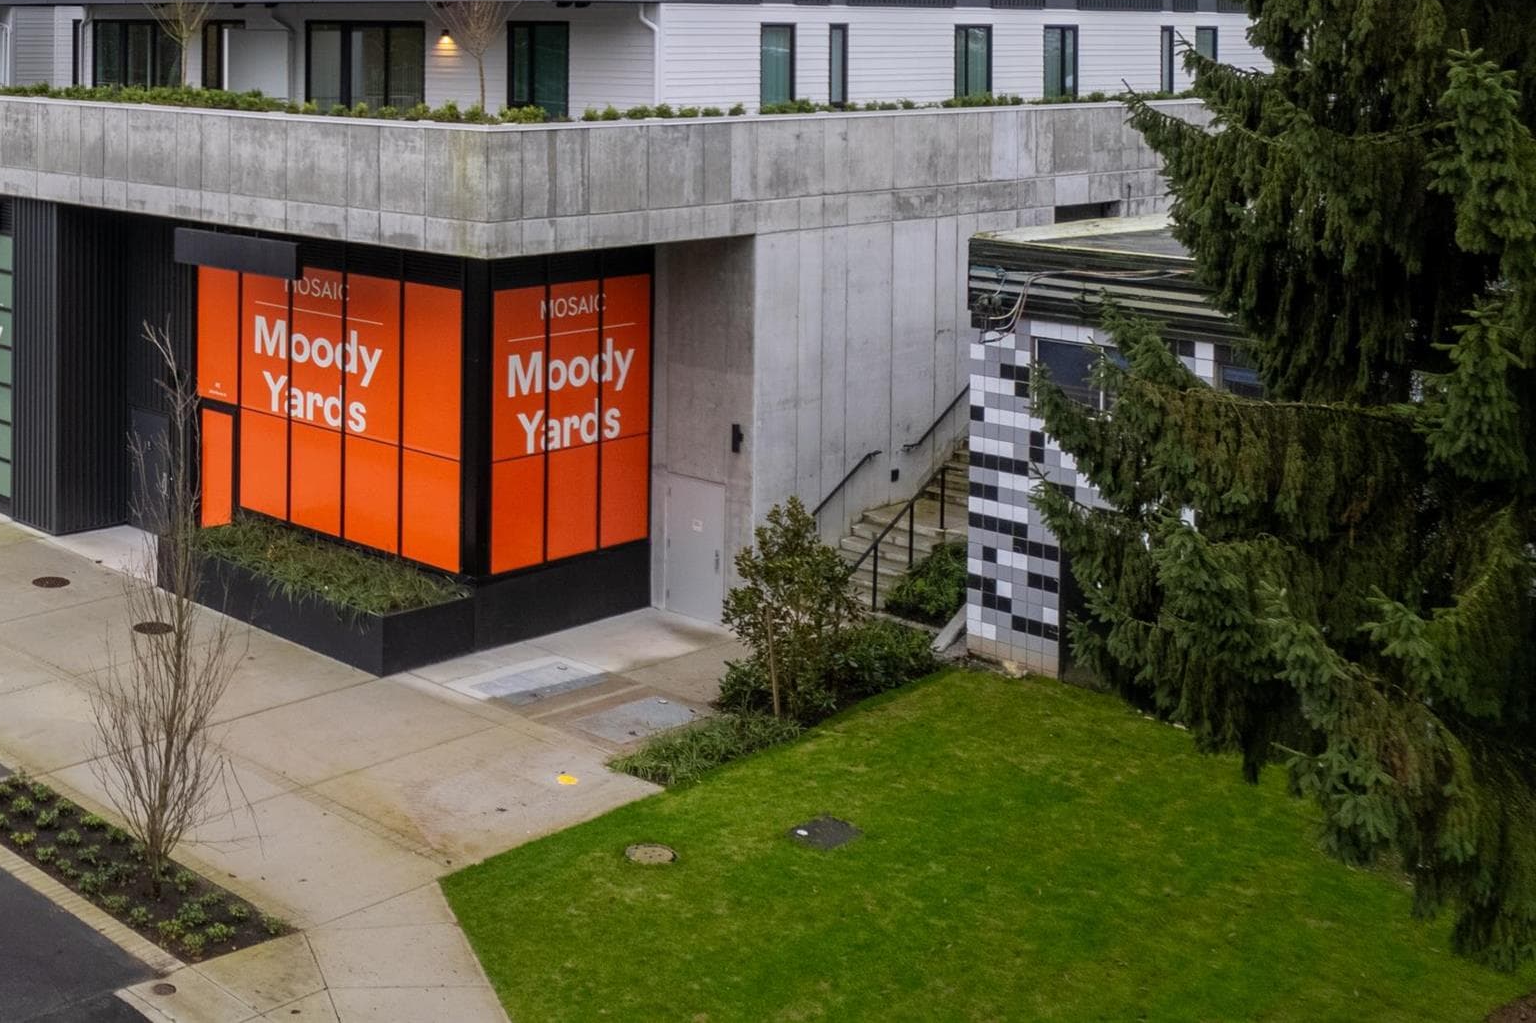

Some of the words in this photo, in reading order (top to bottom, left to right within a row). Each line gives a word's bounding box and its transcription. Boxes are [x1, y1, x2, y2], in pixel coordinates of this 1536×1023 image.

[540, 293, 607, 320] MOSAIC
[254, 315, 383, 387] Moody
[507, 338, 635, 398] Moody
[263, 370, 366, 433] Yards
[516, 397, 621, 455] Yards
